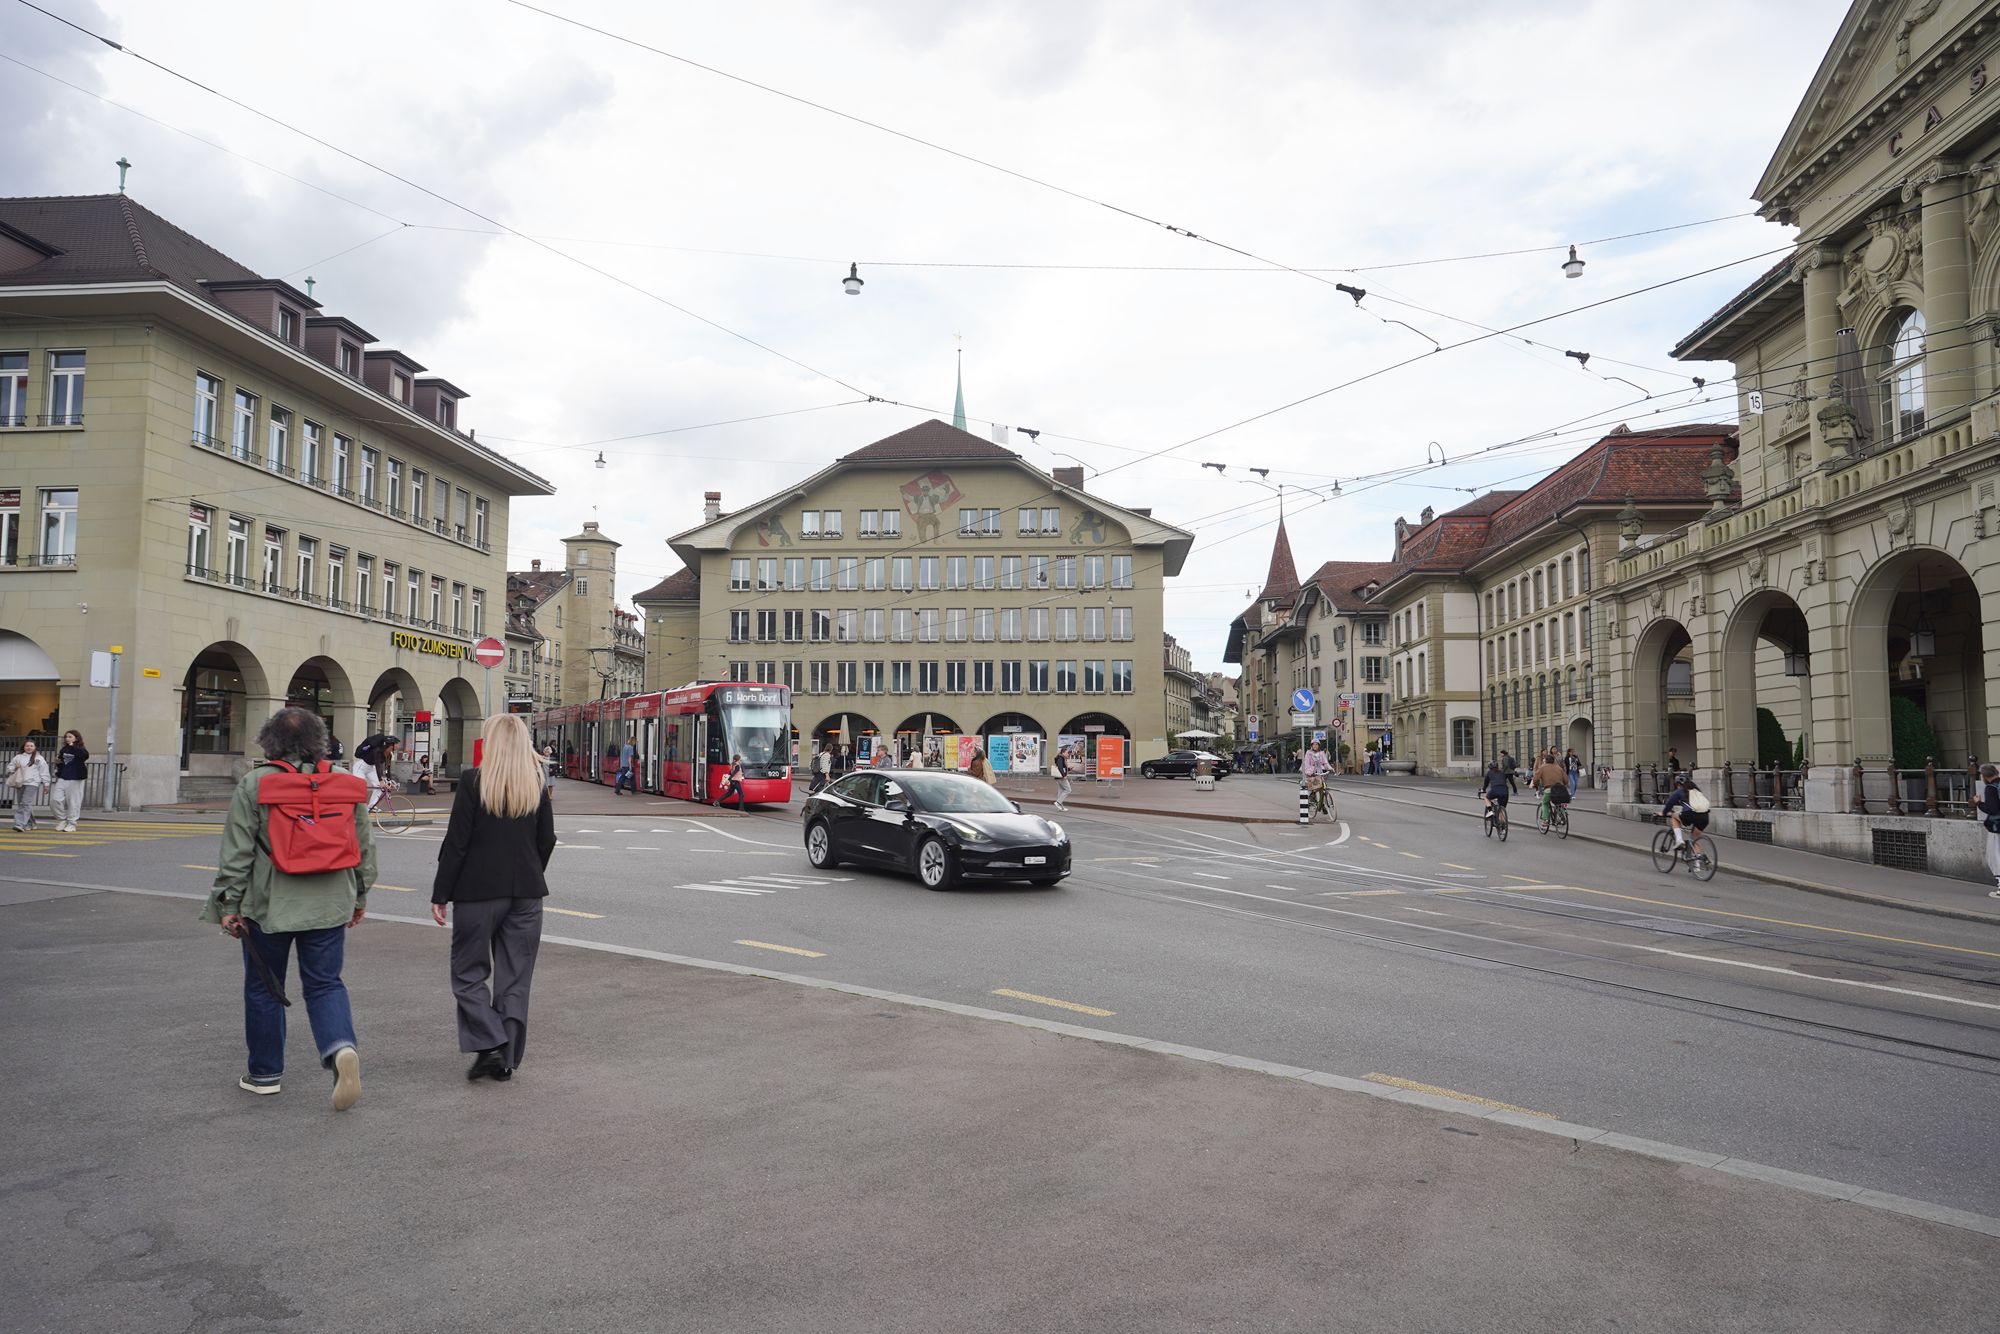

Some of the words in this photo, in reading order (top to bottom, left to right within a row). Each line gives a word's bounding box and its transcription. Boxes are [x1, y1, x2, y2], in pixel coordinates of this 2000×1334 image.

[1750, 396, 1761, 410] 15
[393, 631, 419, 650] FOTO
[421, 638, 464, 658] ZUMSTEIN
[726, 692, 732, 702] 6
[737, 692, 757, 702] Worb
[759, 692, 777, 702] Dorf
